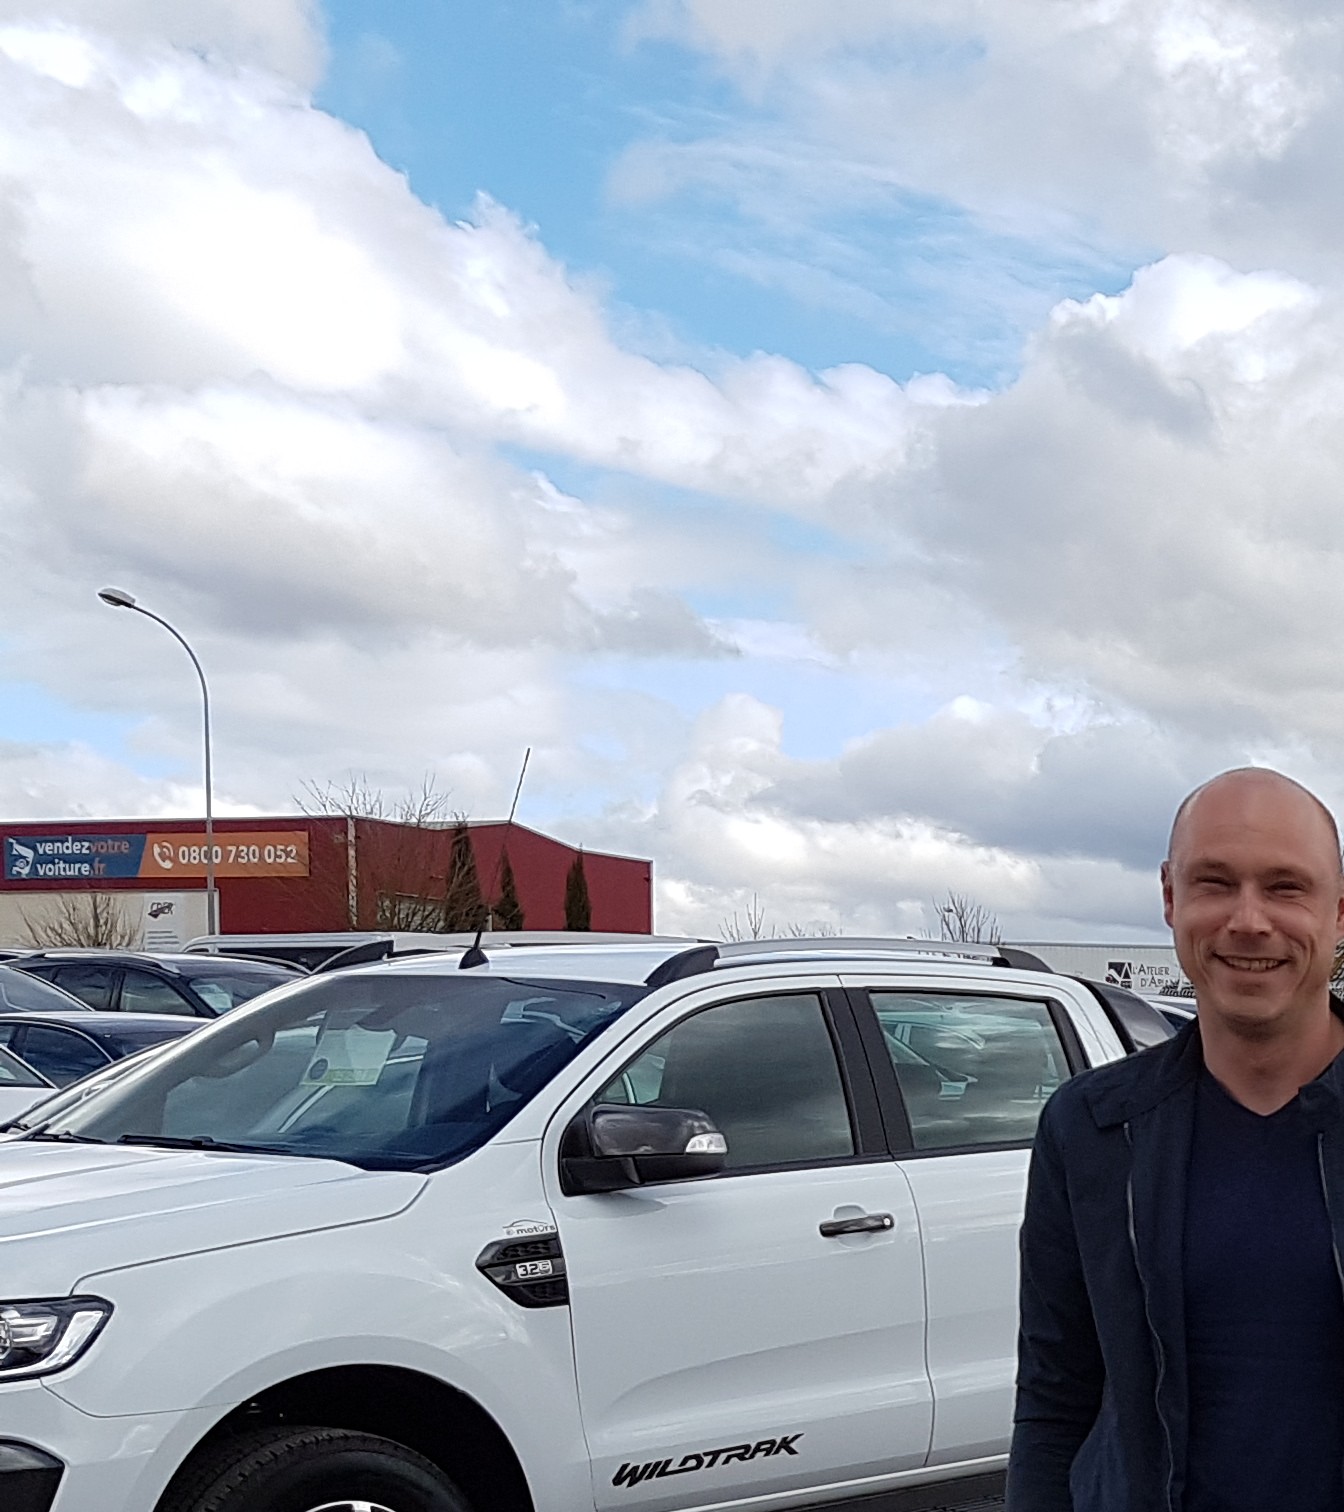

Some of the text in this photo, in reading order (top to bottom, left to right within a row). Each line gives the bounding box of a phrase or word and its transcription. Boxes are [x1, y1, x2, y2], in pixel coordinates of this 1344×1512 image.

[179, 844, 297, 864] 0800 730 052
[36, 858, 107, 876] voiture.fr
[612, 1433, 804, 1488] WILDTRAK
